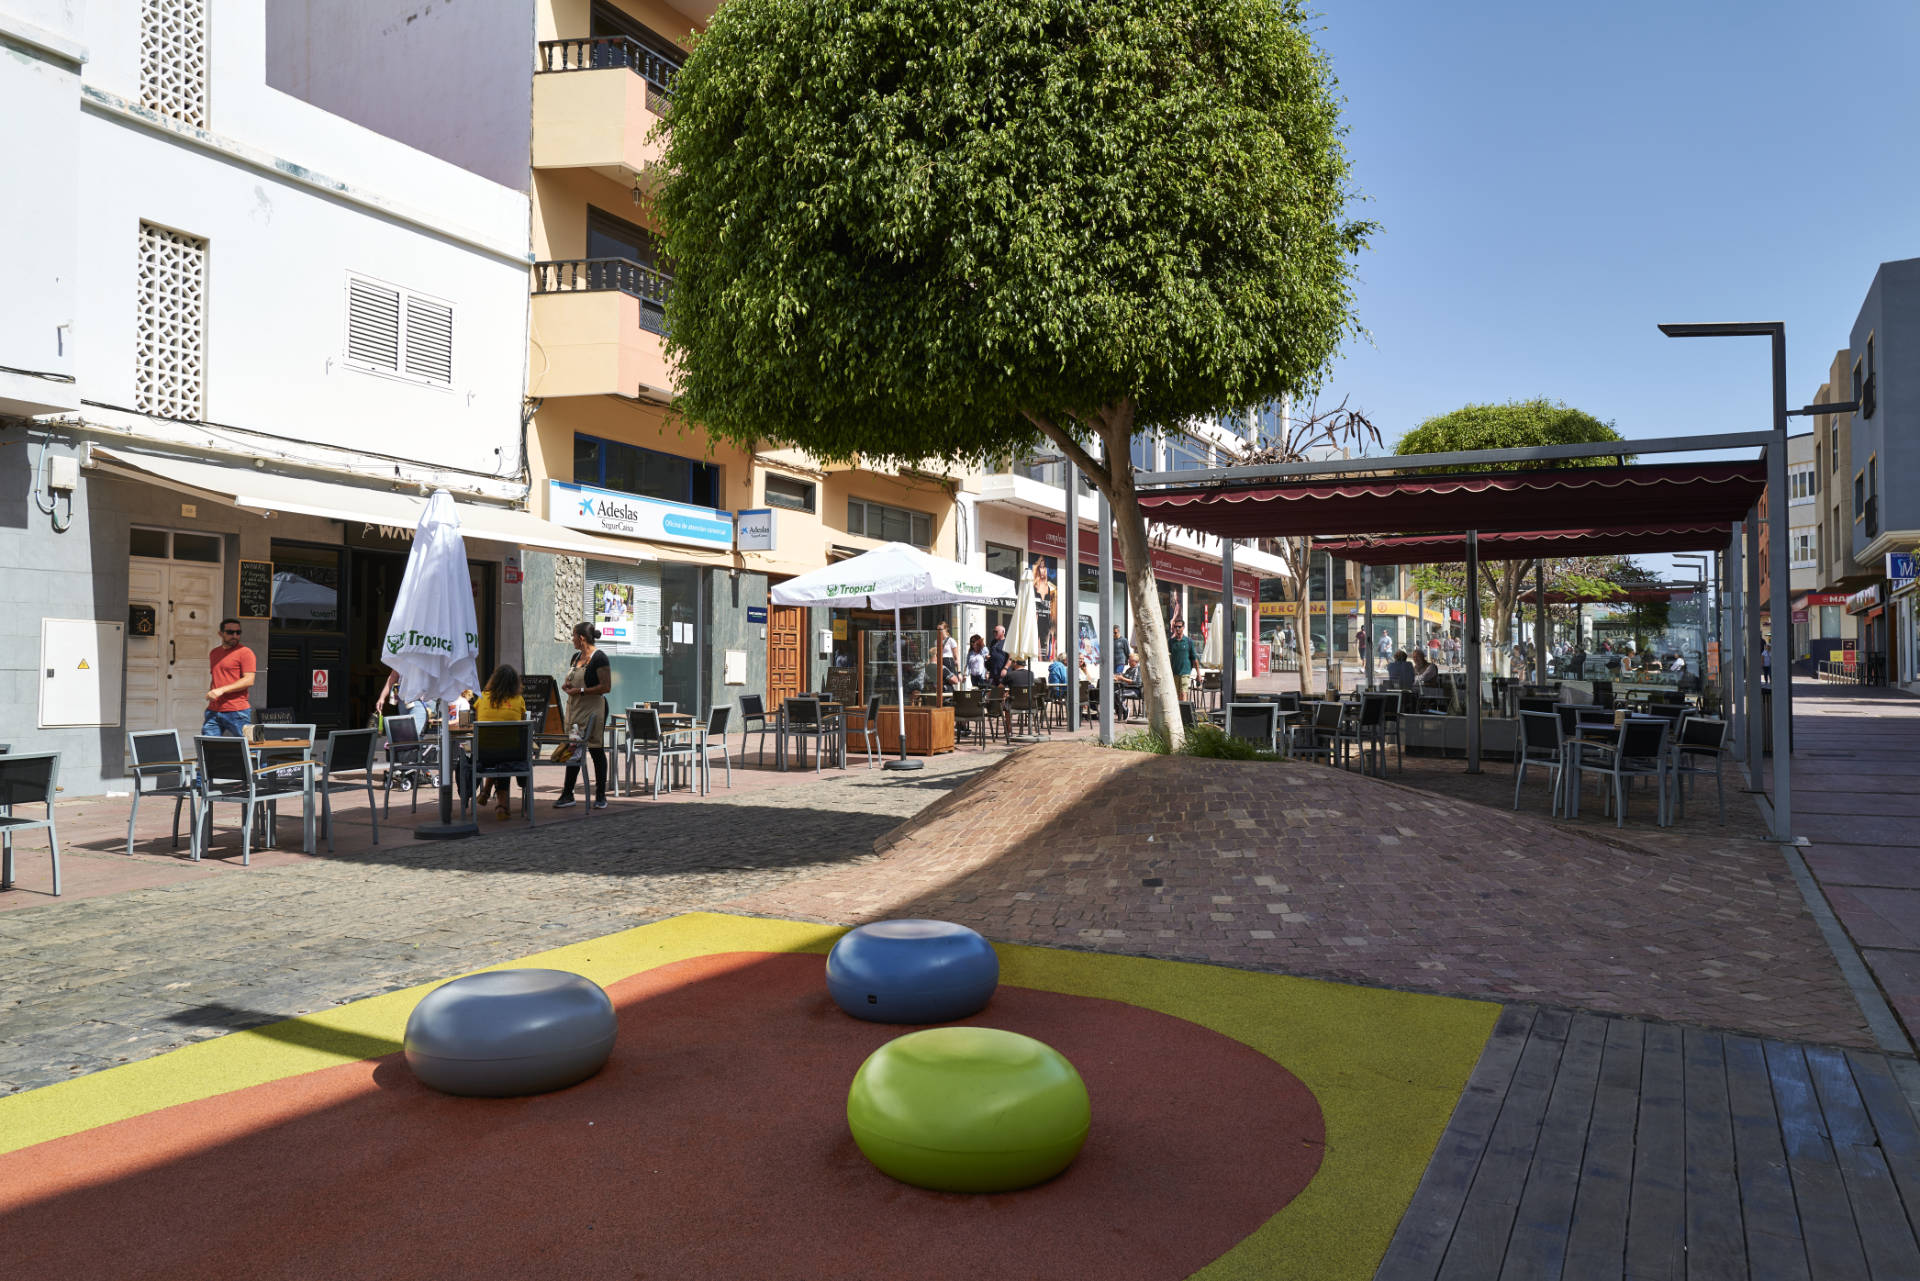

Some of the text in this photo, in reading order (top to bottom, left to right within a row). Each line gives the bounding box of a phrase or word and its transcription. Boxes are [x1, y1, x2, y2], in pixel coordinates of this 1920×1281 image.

[597, 500, 638, 521] Adeslas
[750, 526, 769, 534] Adeslas
[840, 582, 876, 596] Tropical
[1829, 595, 1846, 603] MA
[1262, 604, 1327, 614] UERCNA
